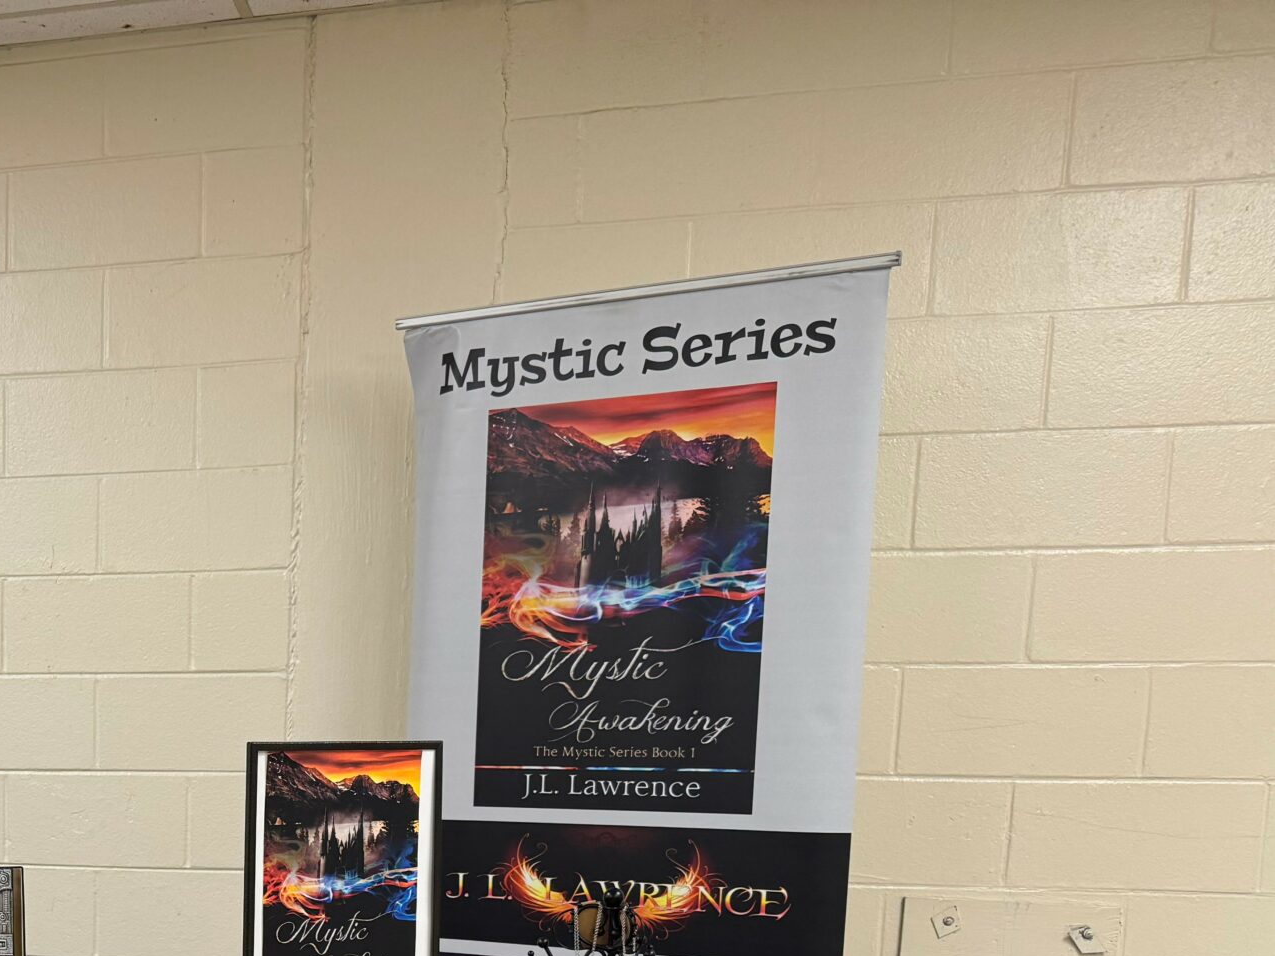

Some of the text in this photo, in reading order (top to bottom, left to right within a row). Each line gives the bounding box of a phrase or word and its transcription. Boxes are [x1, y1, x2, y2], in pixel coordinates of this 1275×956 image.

[438, 317, 838, 398] Mystic Series
[502, 636, 690, 700] Mystic
[548, 698, 735, 744] Awakening
[533, 745, 560, 757] The
[562, 745, 605, 759] Mystic
[608, 746, 648, 758] Series
[652, 747, 686, 759] Book
[522, 773, 702, 799] J.L. Lawrence
[445, 872, 469, 899] J.
[539, 871, 792, 921] LAWRENCE
[276, 911, 380, 955] Mystic
